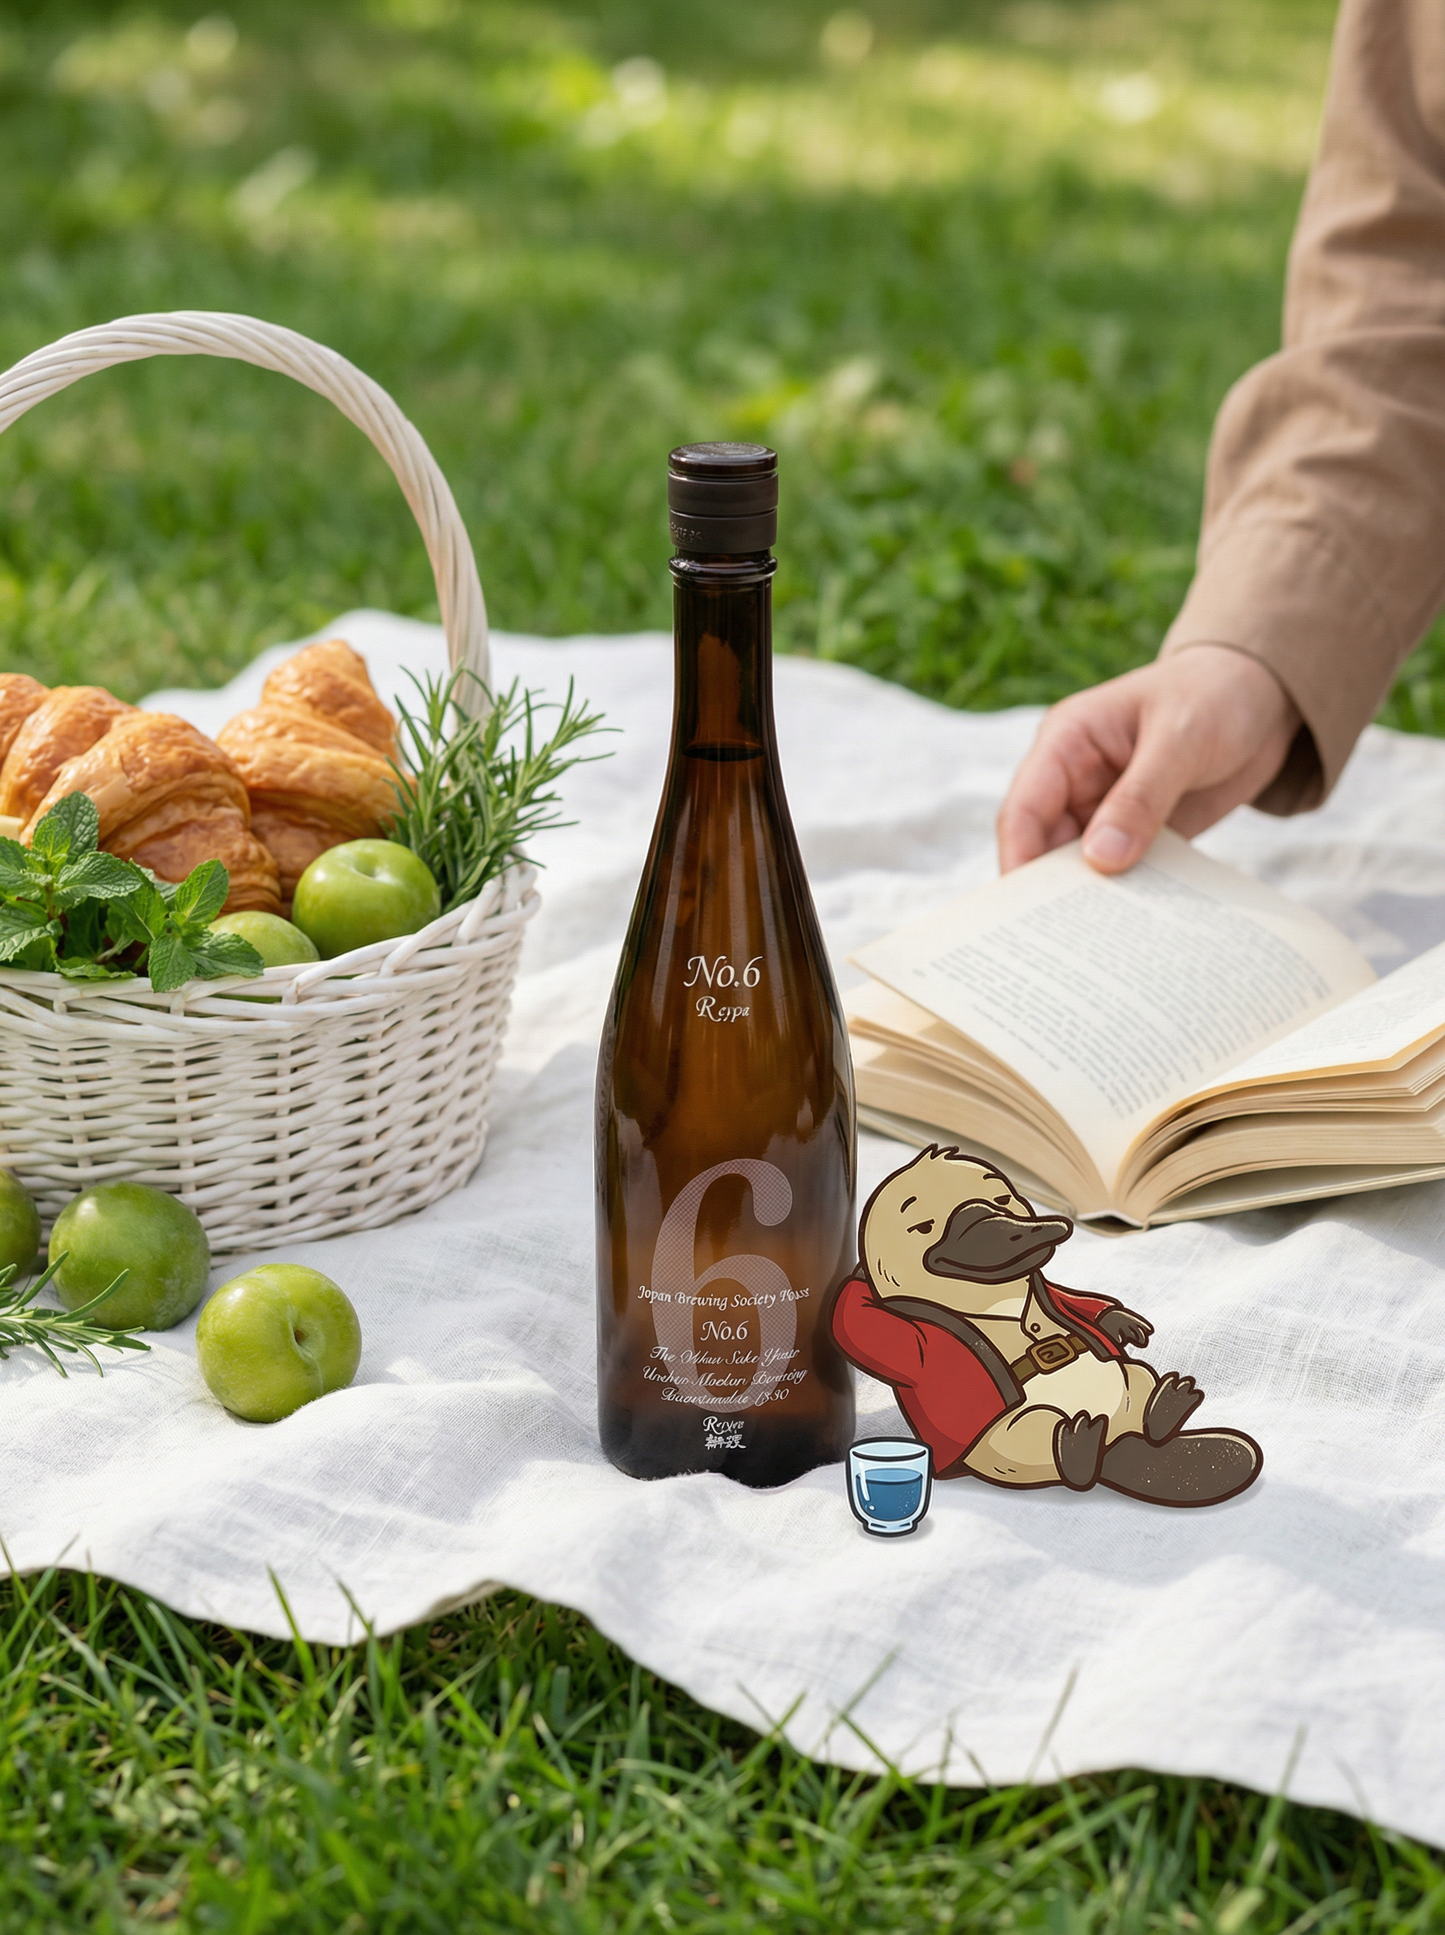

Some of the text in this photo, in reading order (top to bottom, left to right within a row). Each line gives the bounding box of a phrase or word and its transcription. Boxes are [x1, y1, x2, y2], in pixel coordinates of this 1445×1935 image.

[683, 955, 763, 989] No.6
[651, 1158, 797, 1413] 6
[674, 1291, 728, 1311] Brewing
[730, 1293, 776, 1308] Society
[700, 1320, 749, 1341] No.6
[650, 1346, 677, 1363] The
